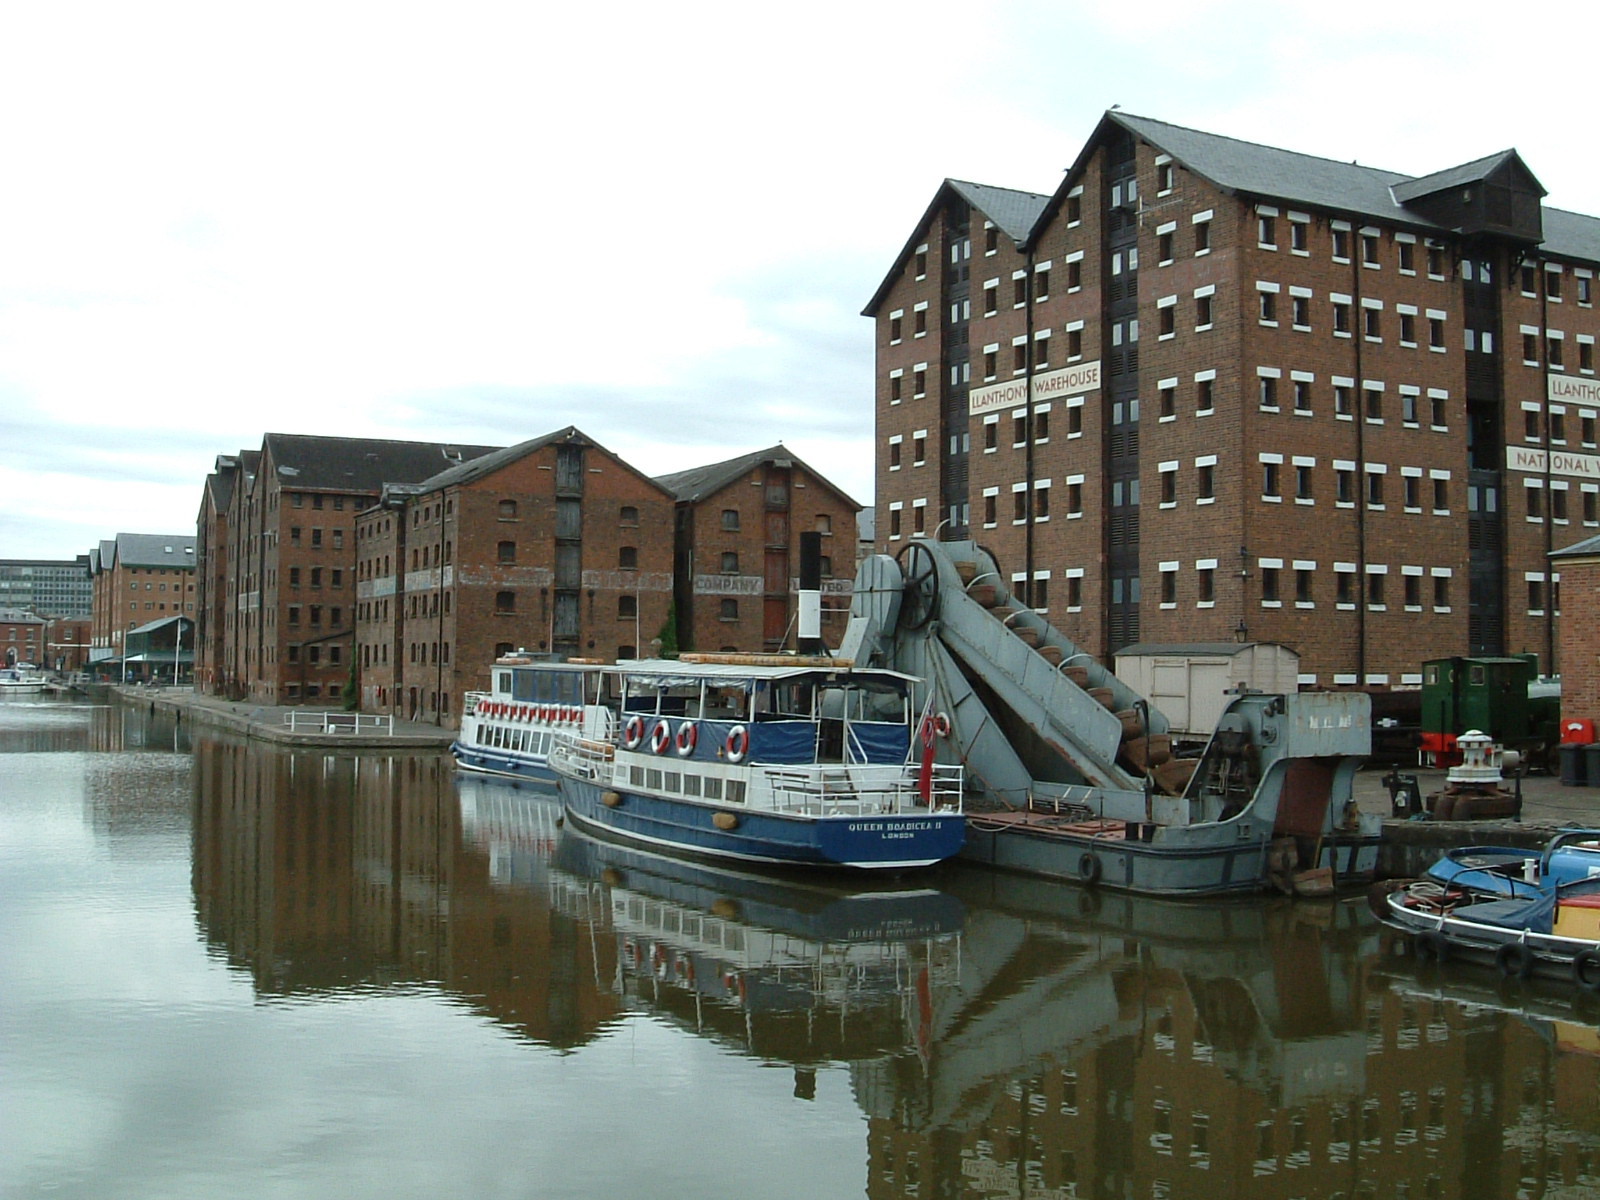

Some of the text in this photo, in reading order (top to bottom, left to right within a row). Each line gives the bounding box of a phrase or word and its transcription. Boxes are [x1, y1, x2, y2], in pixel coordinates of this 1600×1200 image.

[972, 368, 1098, 409] LLANTHONY WAREHOUSE
[1516, 451, 1590, 473] NATONAL
[695, 577, 843, 592] COMPANY LTED
[848, 823, 883, 832] QUEEN
[887, 822, 932, 831] BOADICEA
